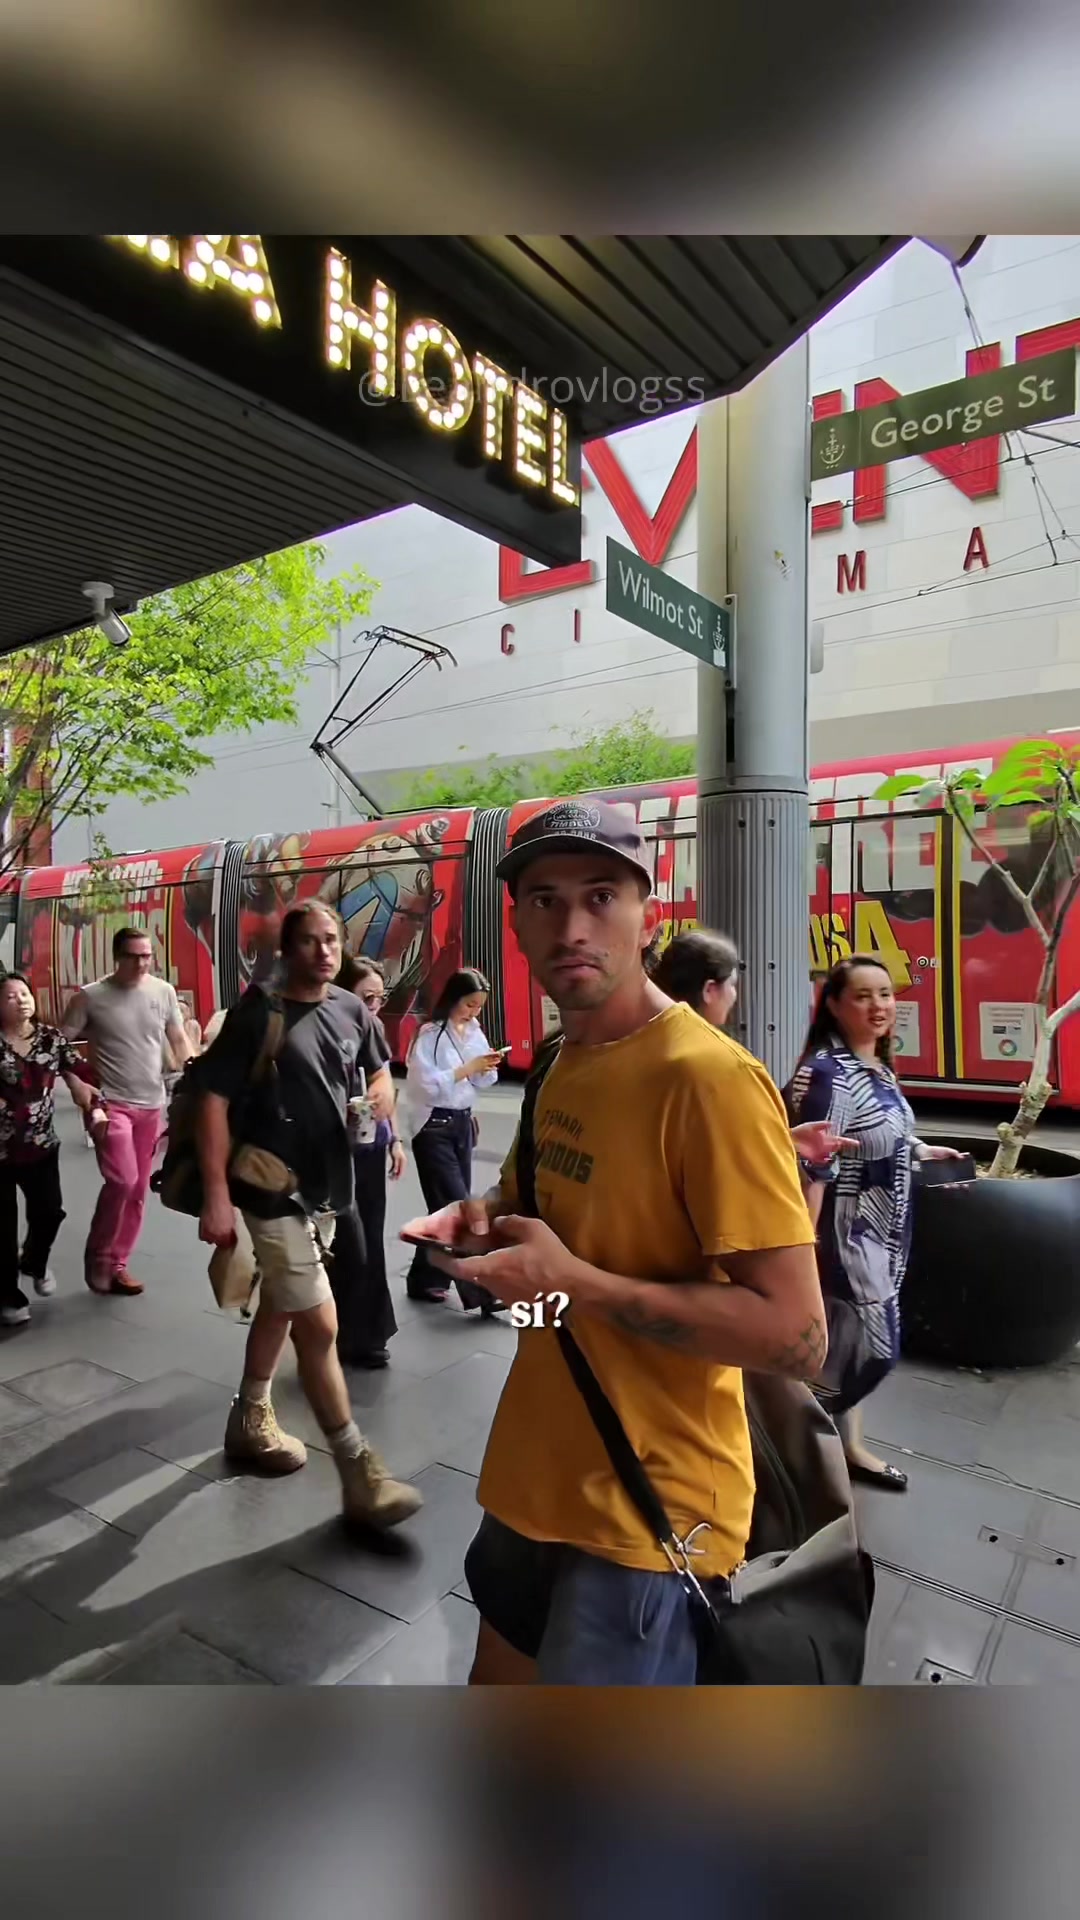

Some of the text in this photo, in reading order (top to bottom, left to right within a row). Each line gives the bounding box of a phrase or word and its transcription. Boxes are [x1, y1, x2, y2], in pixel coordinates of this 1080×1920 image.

[325, 246, 580, 508] HOTEL
[870, 375, 1057, 448] George St
[618, 560, 684, 630] Wilmot
[688, 604, 704, 640] St
